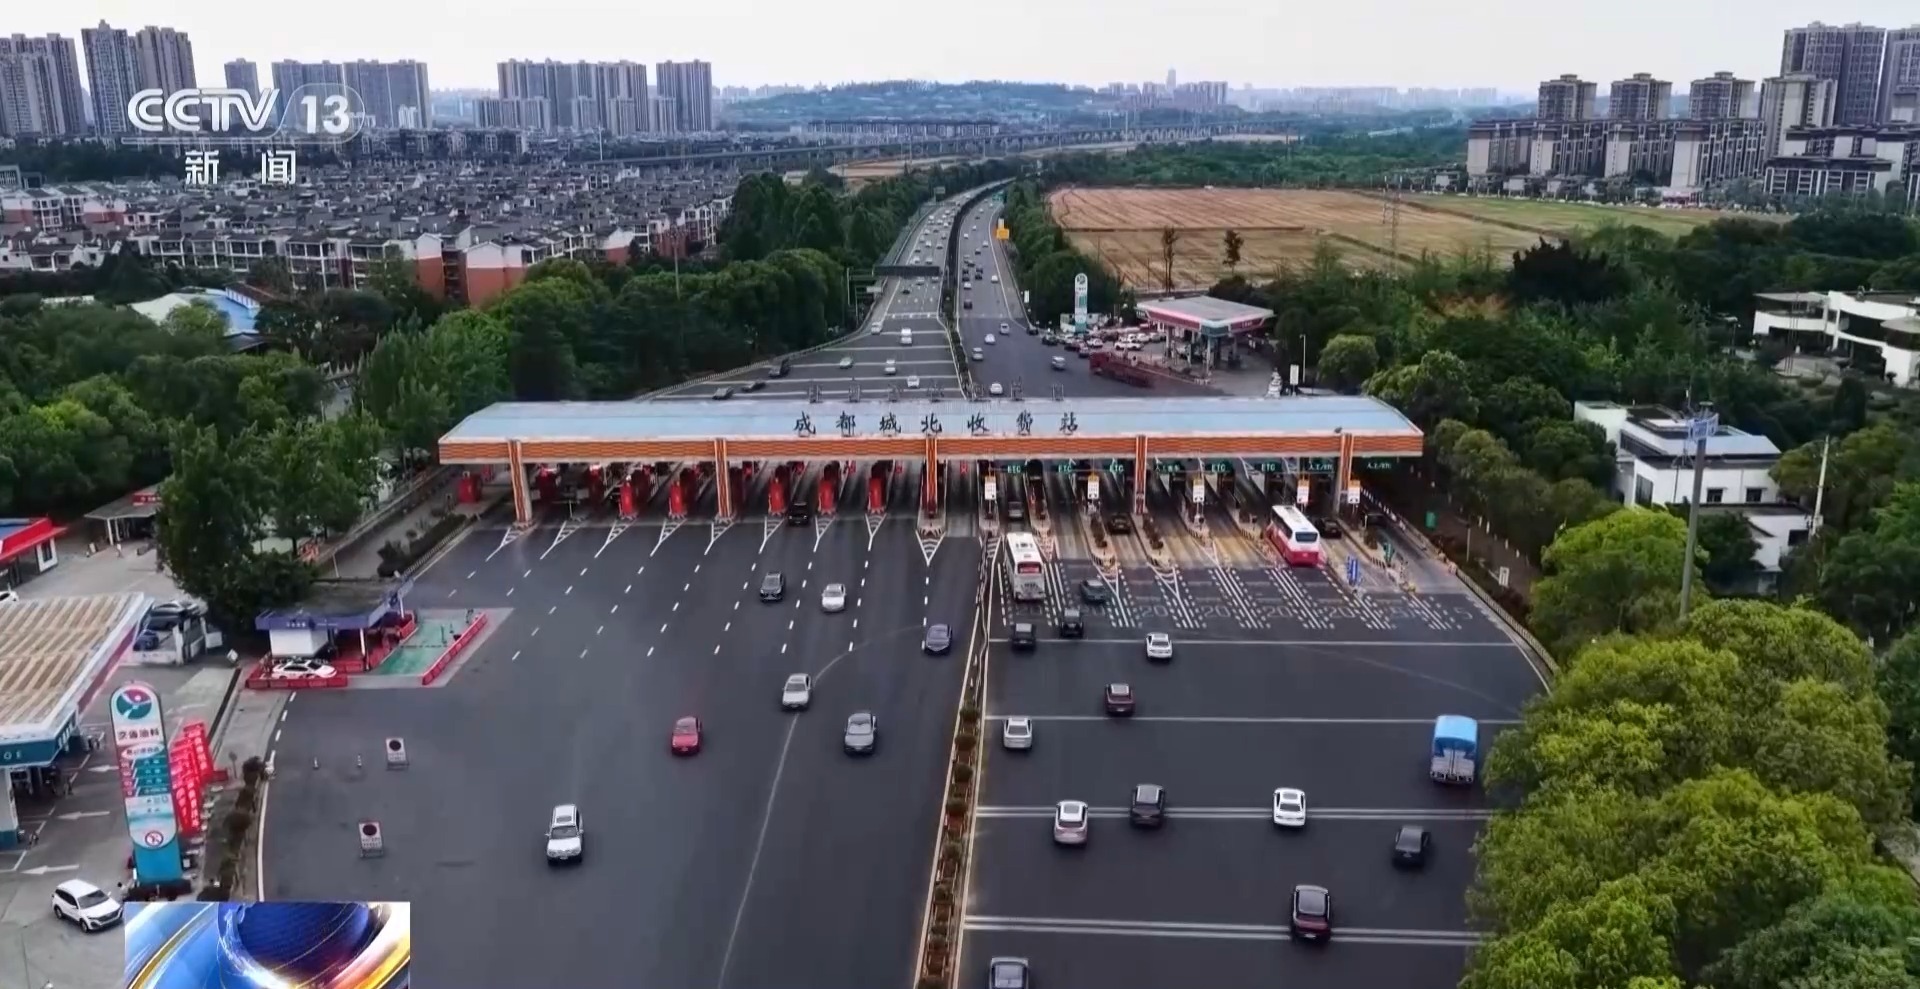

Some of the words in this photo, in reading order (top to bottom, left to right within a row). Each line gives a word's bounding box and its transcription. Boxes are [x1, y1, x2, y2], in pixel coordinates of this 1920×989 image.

[793, 410, 1079, 435] 成都城北收费站
[1007, 465, 1021, 473] ETC
[1058, 465, 1072, 473] ETC
[1109, 464, 1124, 473] ETC
[1211, 463, 1226, 472] ETC
[1261, 463, 1276, 472] ETC
[1141, 605, 1169, 617] 20
[1203, 605, 1231, 617] 20
[1266, 605, 1294, 618] 20
[1328, 605, 1356, 618] 20
